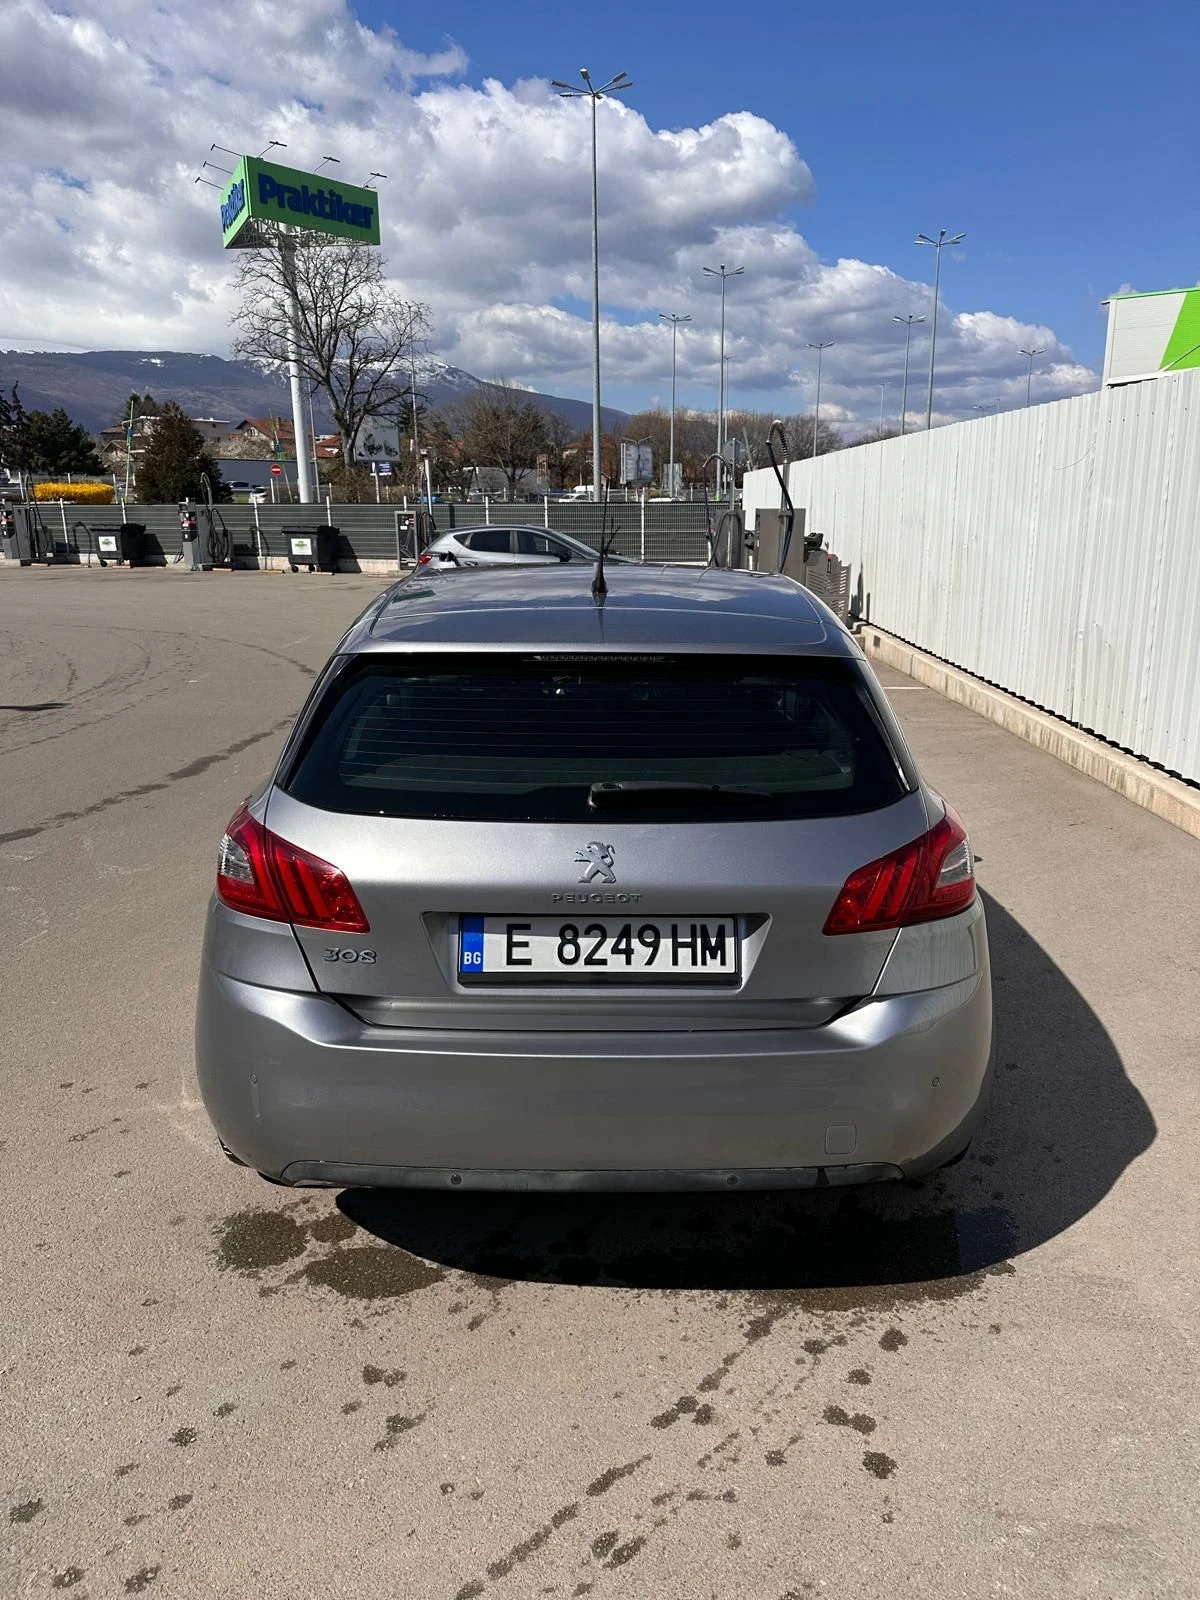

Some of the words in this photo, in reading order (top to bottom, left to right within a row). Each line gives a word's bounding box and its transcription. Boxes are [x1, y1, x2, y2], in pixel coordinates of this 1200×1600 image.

[258, 174, 373, 229] Praktiker
[551, 893, 643, 903] PEUGEOT
[506, 923, 532, 966] E
[322, 947, 377, 964] 308
[463, 951, 482, 965] BG
